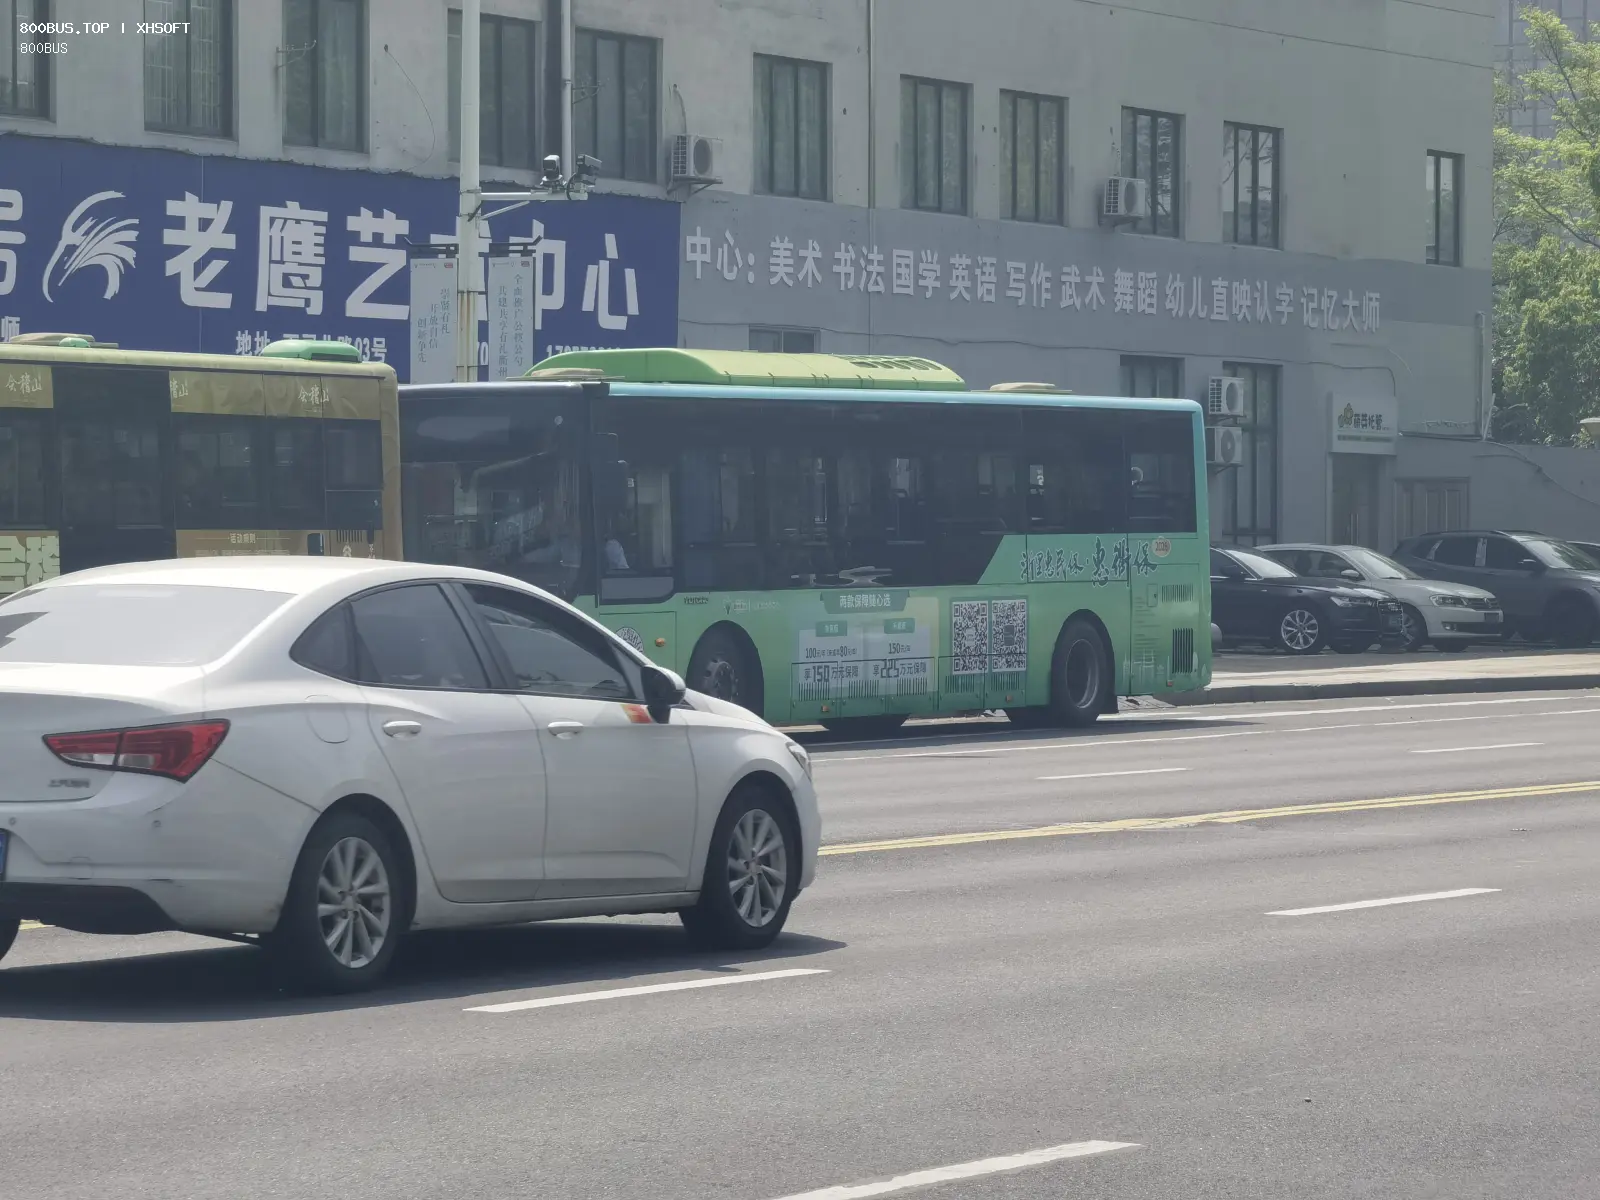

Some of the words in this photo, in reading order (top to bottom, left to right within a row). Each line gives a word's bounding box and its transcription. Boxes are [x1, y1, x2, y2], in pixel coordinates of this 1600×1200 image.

[769, 235, 822, 288] 美术
[832, 242, 885, 294] 书法
[892, 248, 941, 299] 国学
[949, 254, 998, 303] 英语
[1005, 261, 1052, 308] 写作
[1060, 264, 1105, 311] 武术
[1113, 267, 1158, 315] 舞蹈
[1301, 285, 1381, 333] 记忆大师
